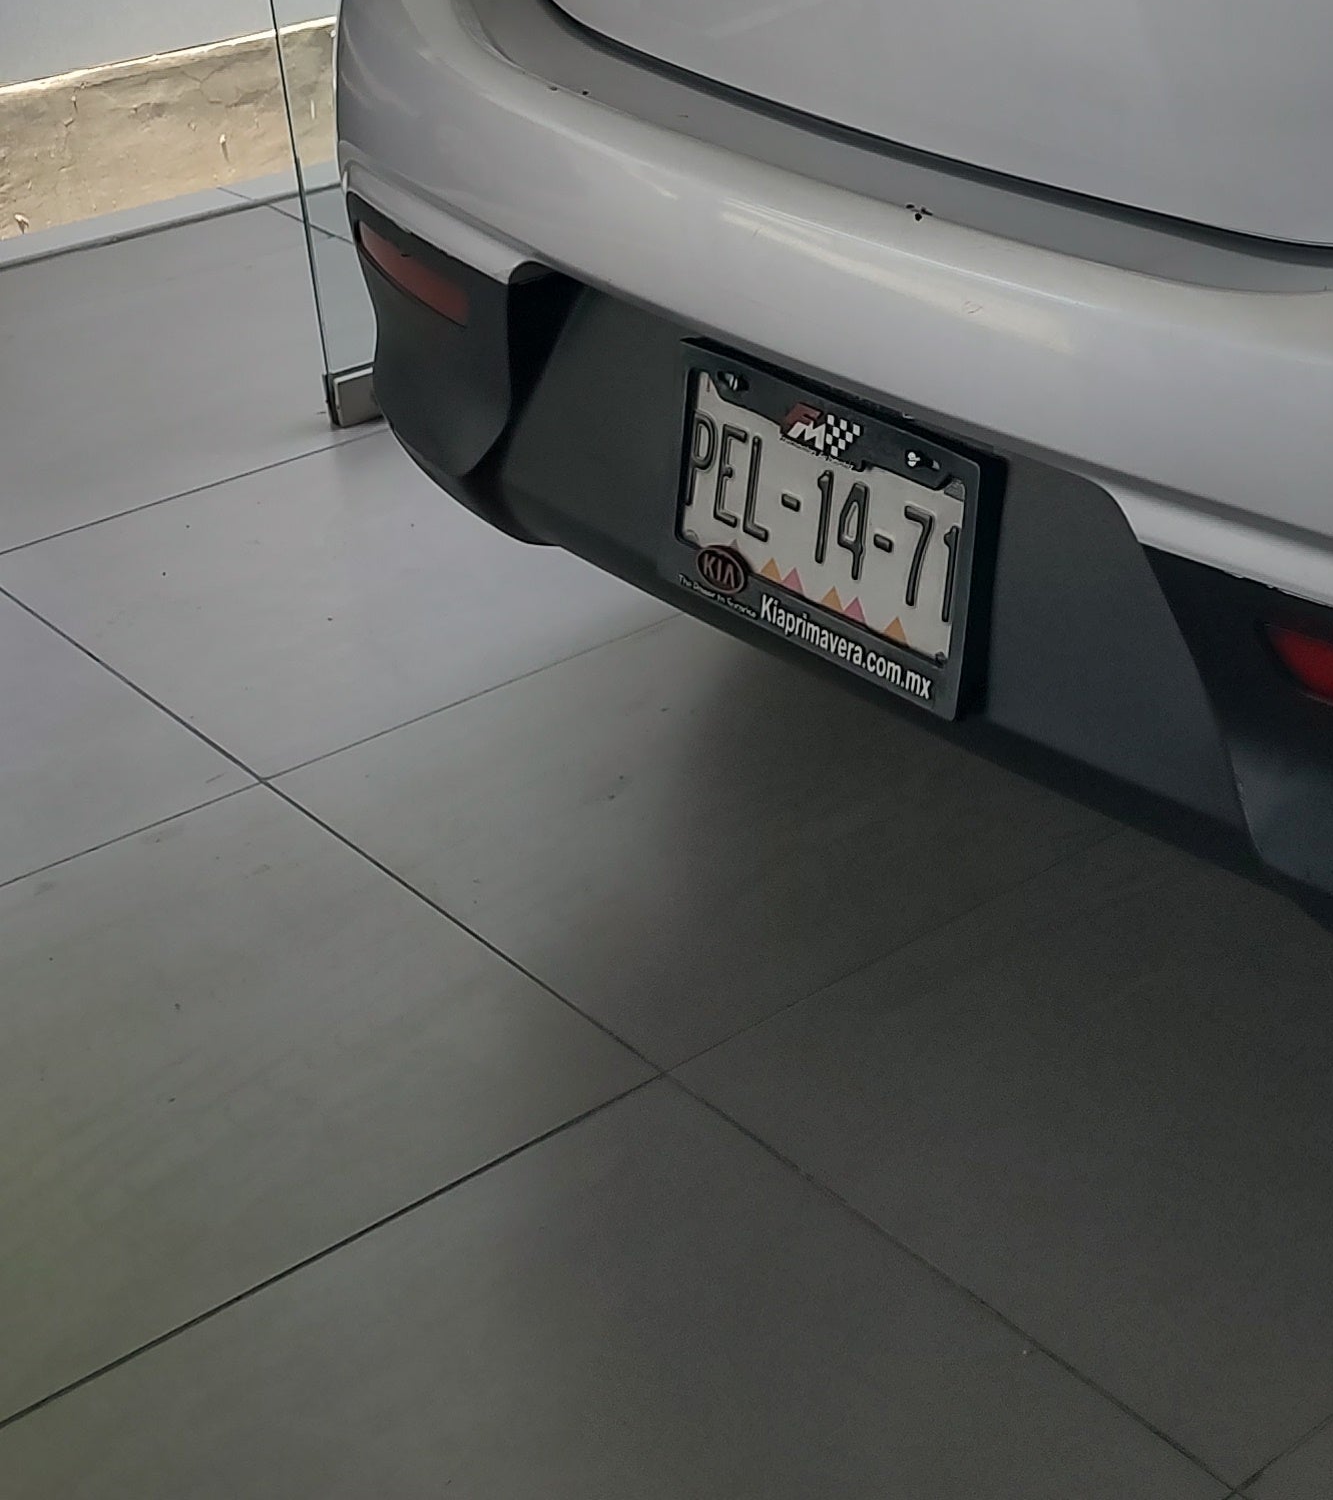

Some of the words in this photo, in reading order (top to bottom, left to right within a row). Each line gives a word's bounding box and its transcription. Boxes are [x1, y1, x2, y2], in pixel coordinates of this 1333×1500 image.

[685, 410, 960, 623] PEL-14-71
[703, 556, 737, 589] KIA
[760, 594, 932, 700] Kiaprimavera.com.mx
